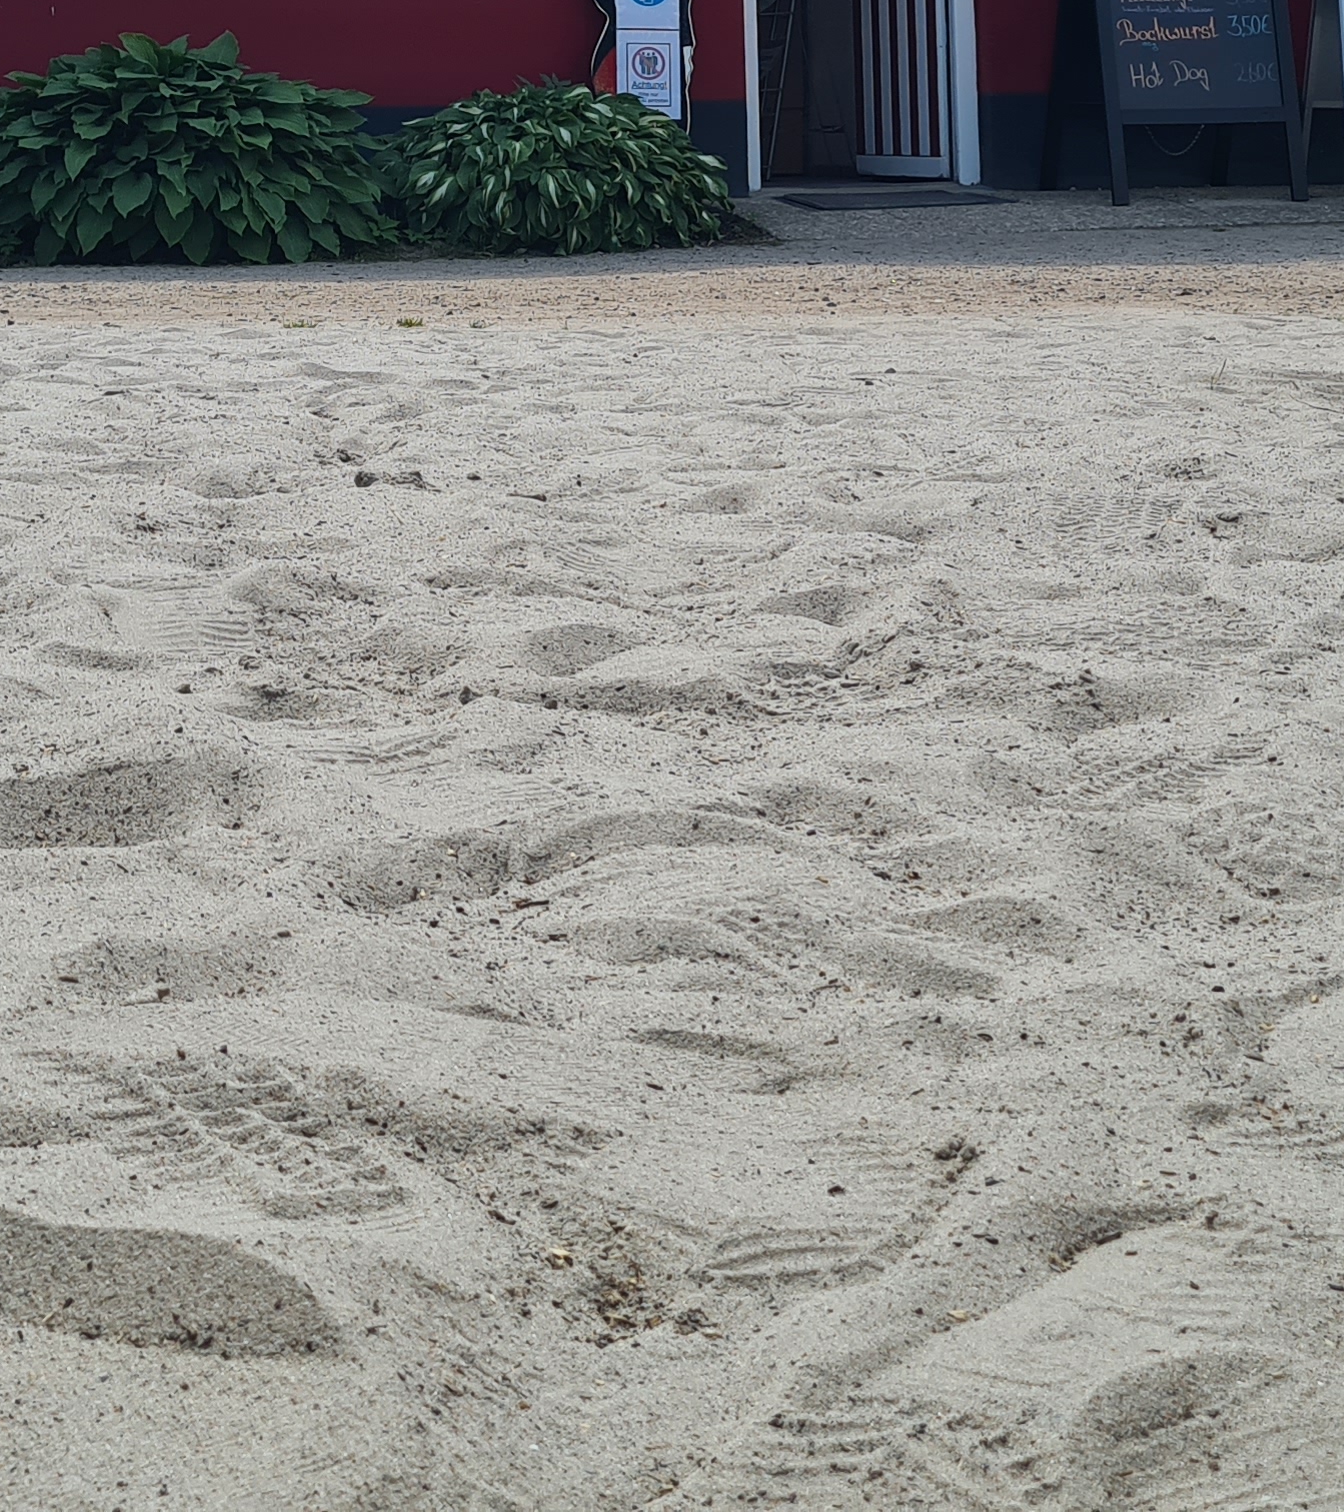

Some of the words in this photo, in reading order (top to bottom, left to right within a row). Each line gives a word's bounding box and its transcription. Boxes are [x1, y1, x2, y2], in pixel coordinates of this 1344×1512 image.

[1116, 16, 1220, 46] Bockwurst
[631, 80, 668, 91] Achtung!
[1129, 61, 1164, 89] Hot
[1169, 60, 1211, 91] Dog
